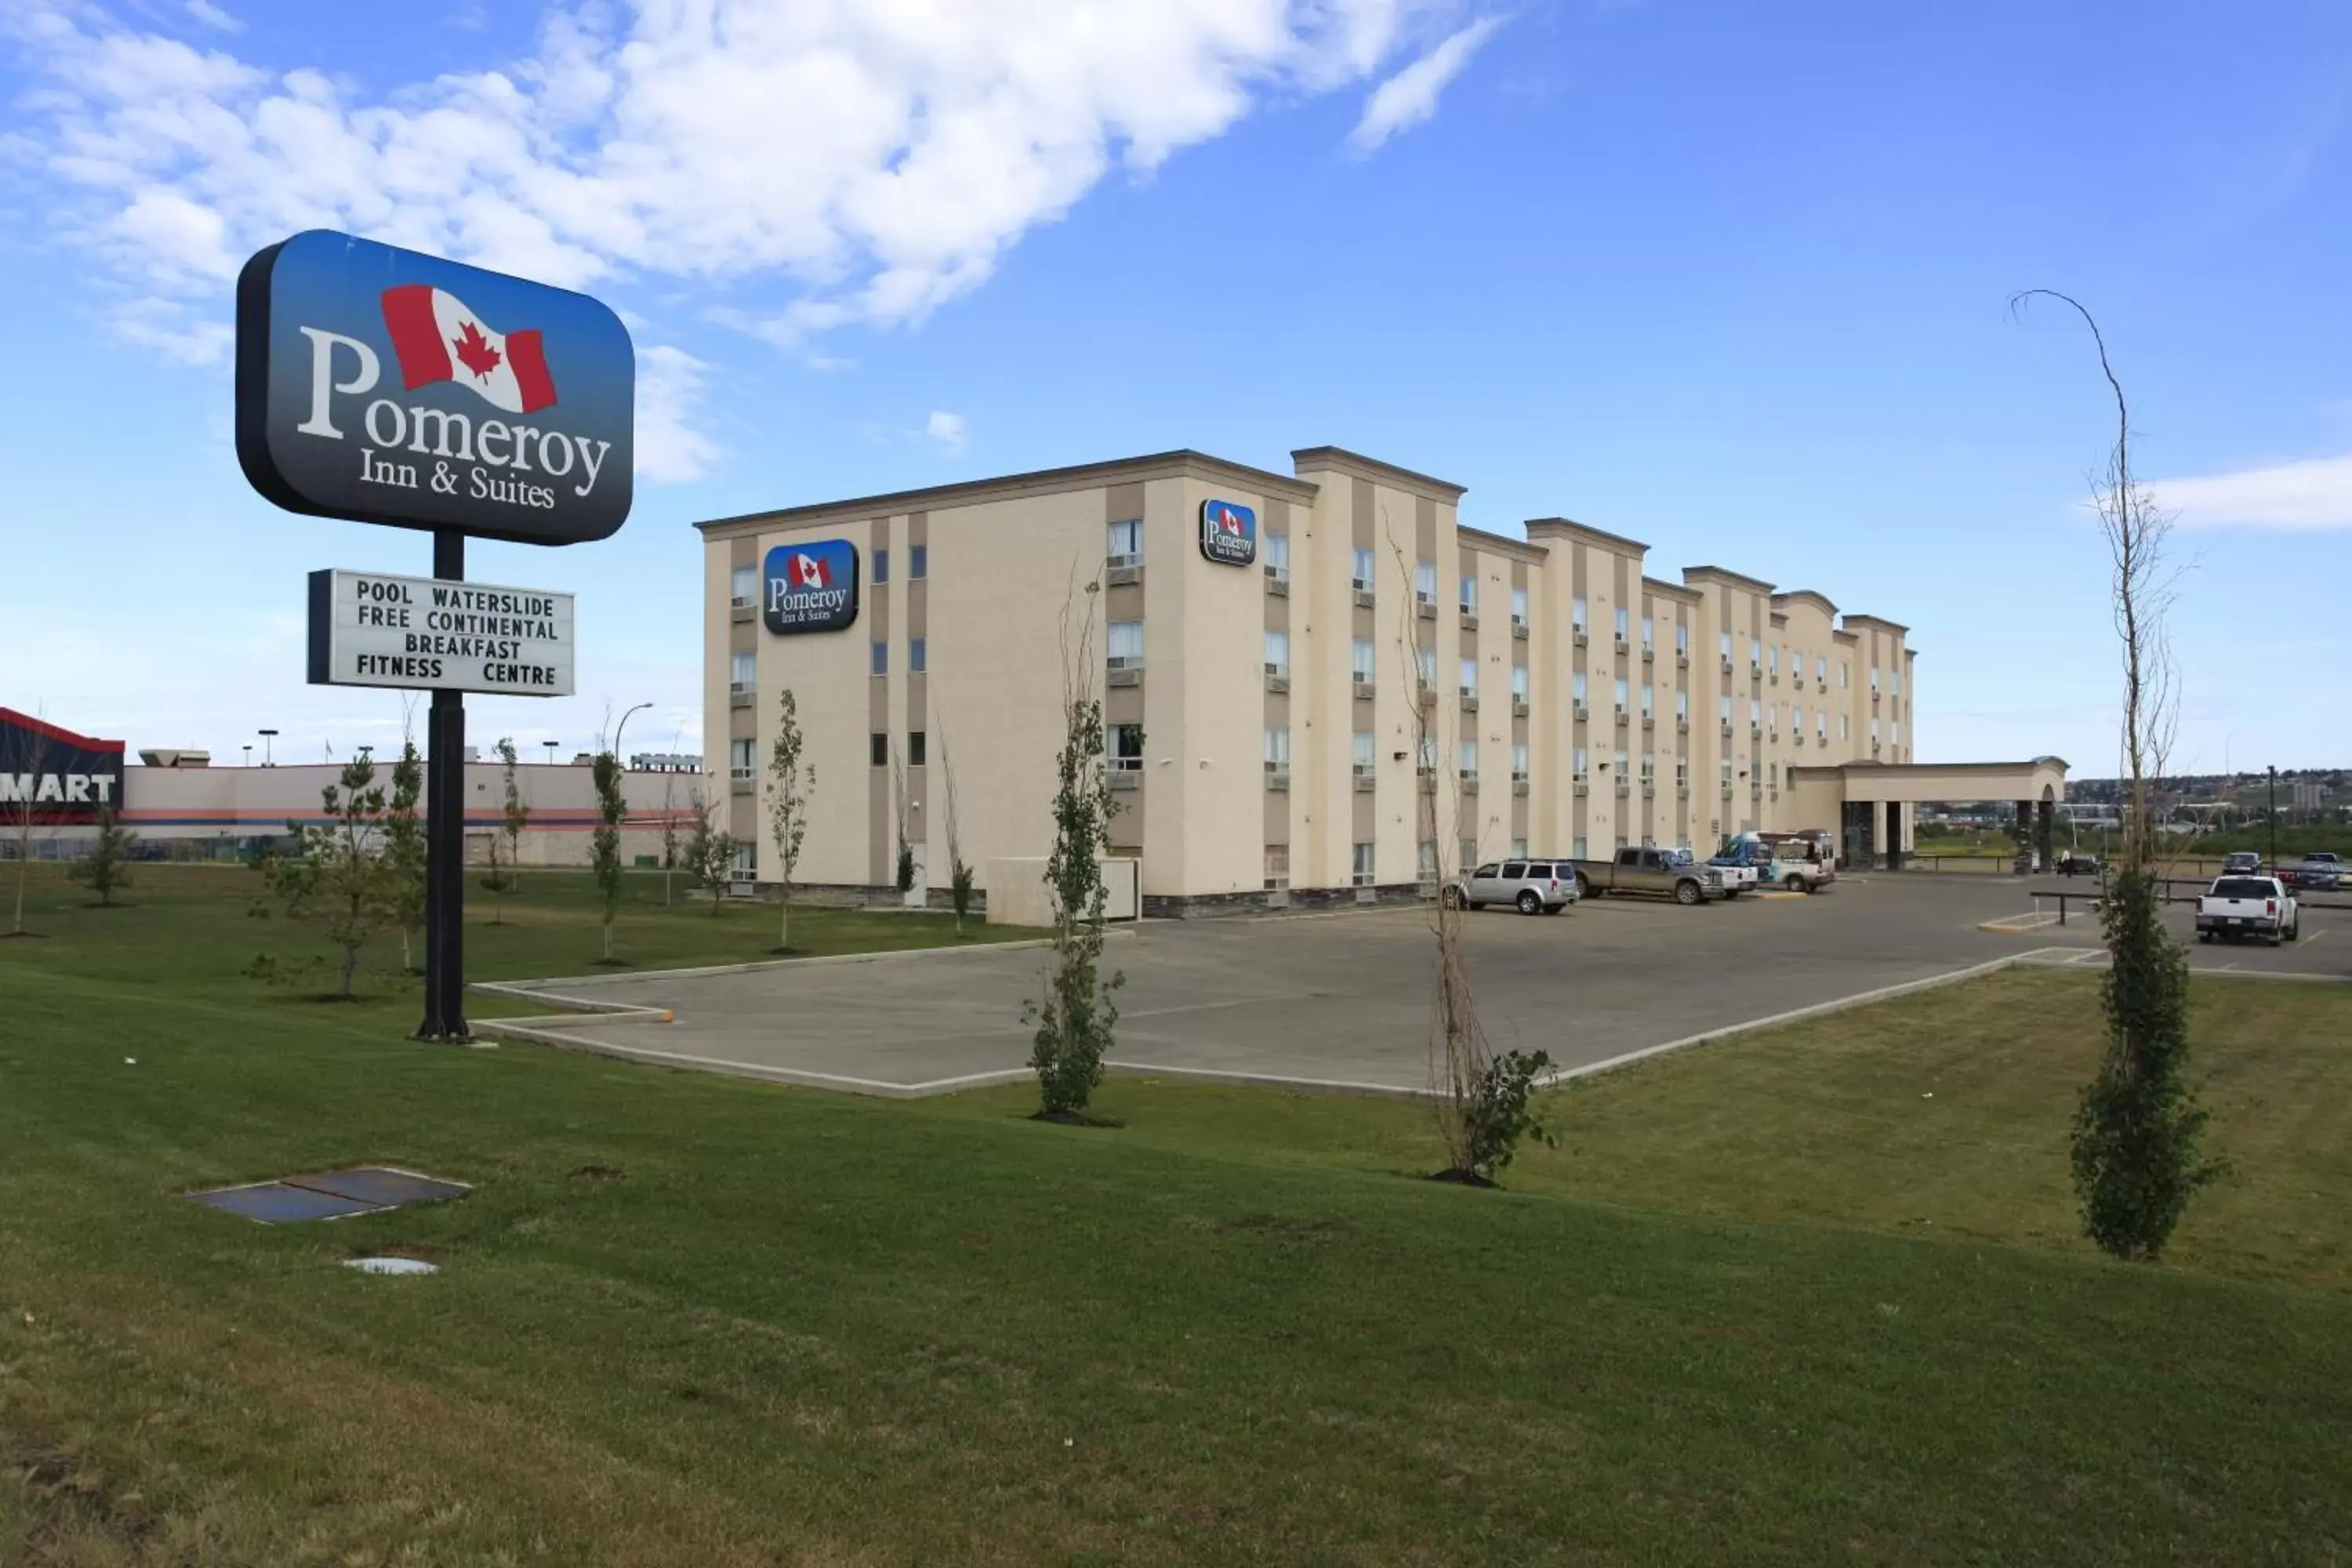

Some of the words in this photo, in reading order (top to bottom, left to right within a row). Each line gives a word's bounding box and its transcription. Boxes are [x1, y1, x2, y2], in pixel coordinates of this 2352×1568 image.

[297, 325, 611, 496] Pomeroy
[361, 448, 419, 488] Inn
[431, 461, 458, 495] &
[470, 468, 555, 509] Suites
[357, 580, 413, 604] POOL
[432, 587, 553, 617] WATERSLIDE
[768, 578, 847, 612] Pomeroy
[358, 605, 410, 628] FREE
[426, 612, 558, 641] CONTINENTAL
[405, 633, 521, 659] BREAKFAST
[357, 654, 443, 678] FITNESS
[483, 662, 556, 685] CENTRE
[0, 772, 116, 802] MART
